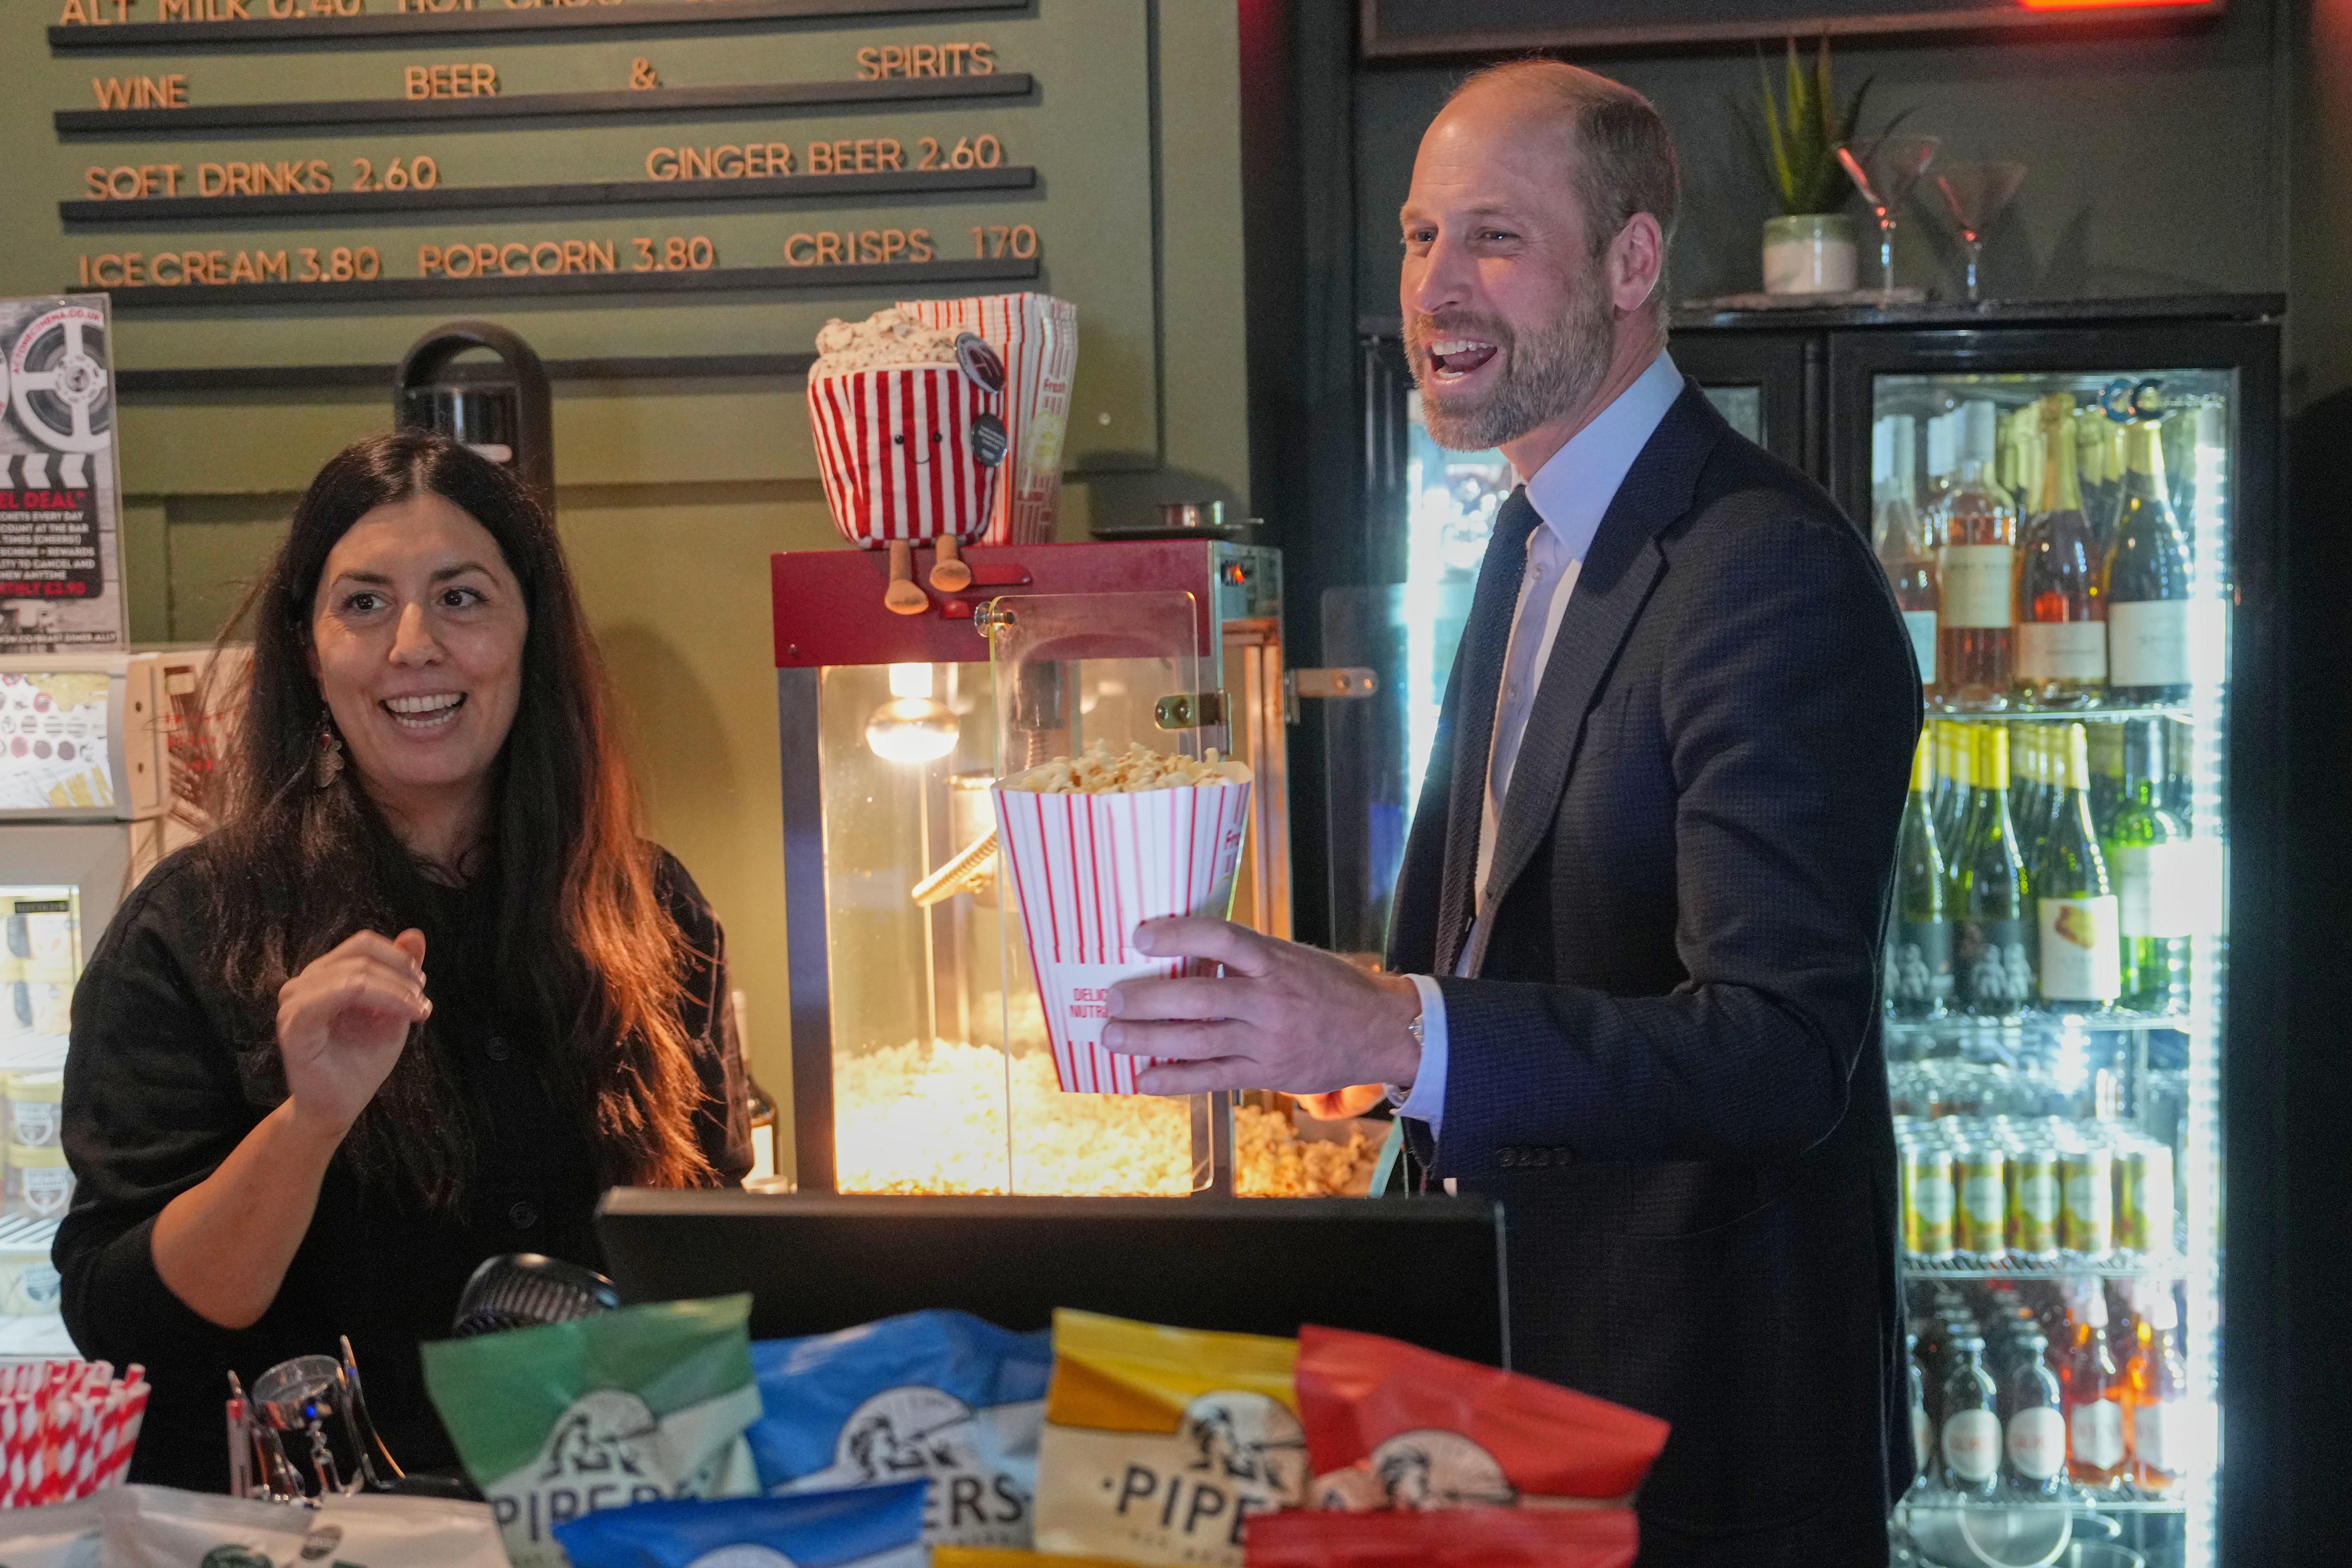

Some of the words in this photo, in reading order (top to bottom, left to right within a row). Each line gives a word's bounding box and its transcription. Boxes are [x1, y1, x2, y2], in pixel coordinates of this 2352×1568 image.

[58, 0, 130, 26] ALT
[158, 0, 250, 22] MILK
[92, 74, 188, 110] WINE
[404, 63, 497, 101] BEER
[629, 57, 658, 90] &
[856, 42, 994, 81] SPIRITS
[84, 164, 182, 201] SOFT
[197, 160, 332, 197] DRINKS
[351, 155, 438, 192] 2.60
[645, 143, 791, 182] GINGER
[807, 139, 902, 175] BEER
[918, 135, 1001, 171] 2.60
[79, 252, 144, 287] ICE
[150, 249, 288, 285] CREAM
[299, 246, 381, 282] 3.80
[419, 239, 617, 278] POPCORN
[632, 236, 714, 273] 3.80
[784, 229, 932, 266] CRISPS
